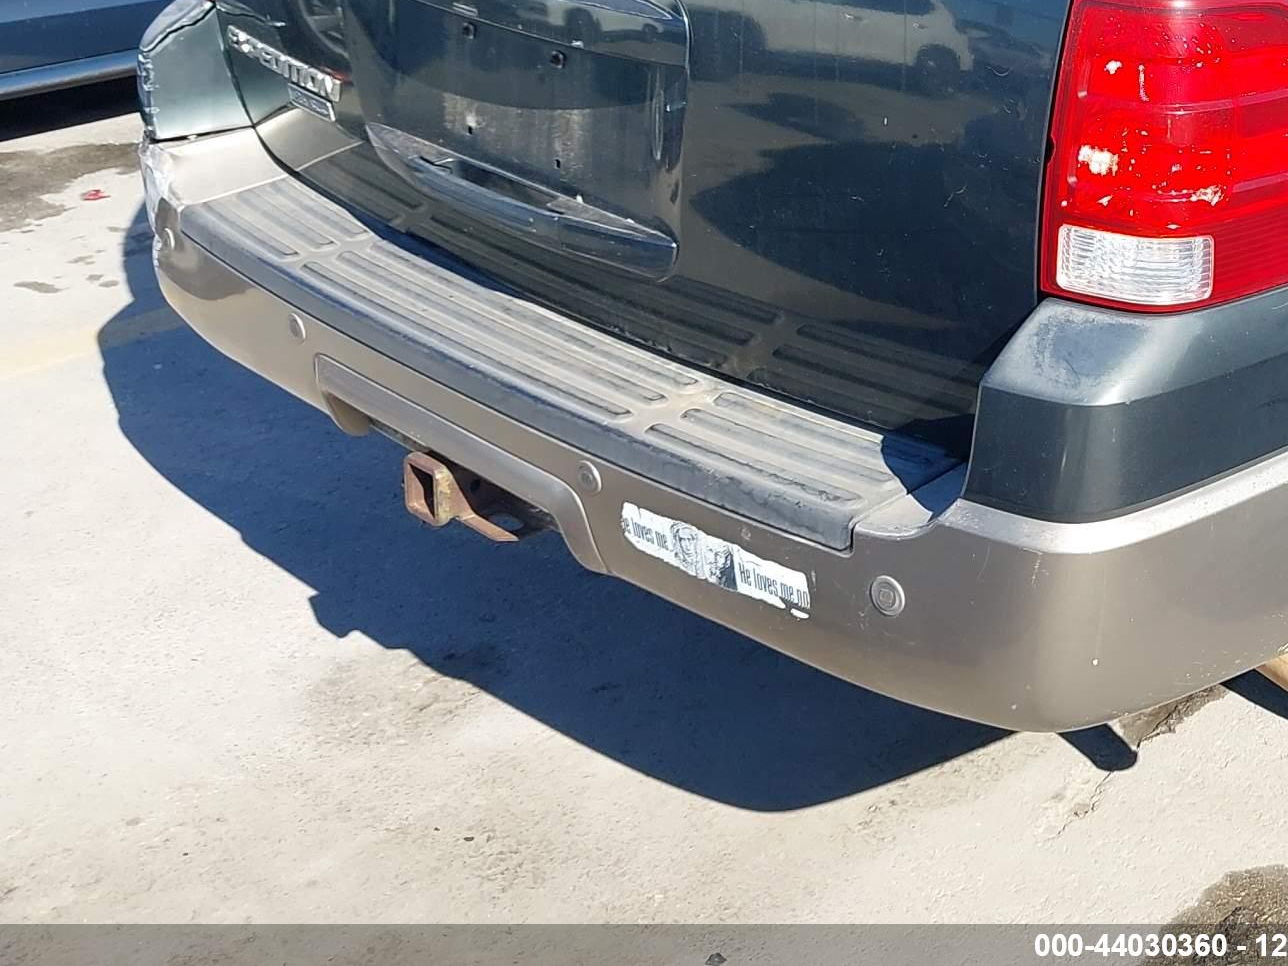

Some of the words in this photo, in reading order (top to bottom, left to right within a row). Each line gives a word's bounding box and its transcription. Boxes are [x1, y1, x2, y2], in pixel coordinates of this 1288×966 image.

[632, 518, 654, 543] loves
[655, 531, 668, 550] me
[738, 562, 751, 586] He
[753, 568, 779, 597] loves
[781, 582, 795, 603] me
